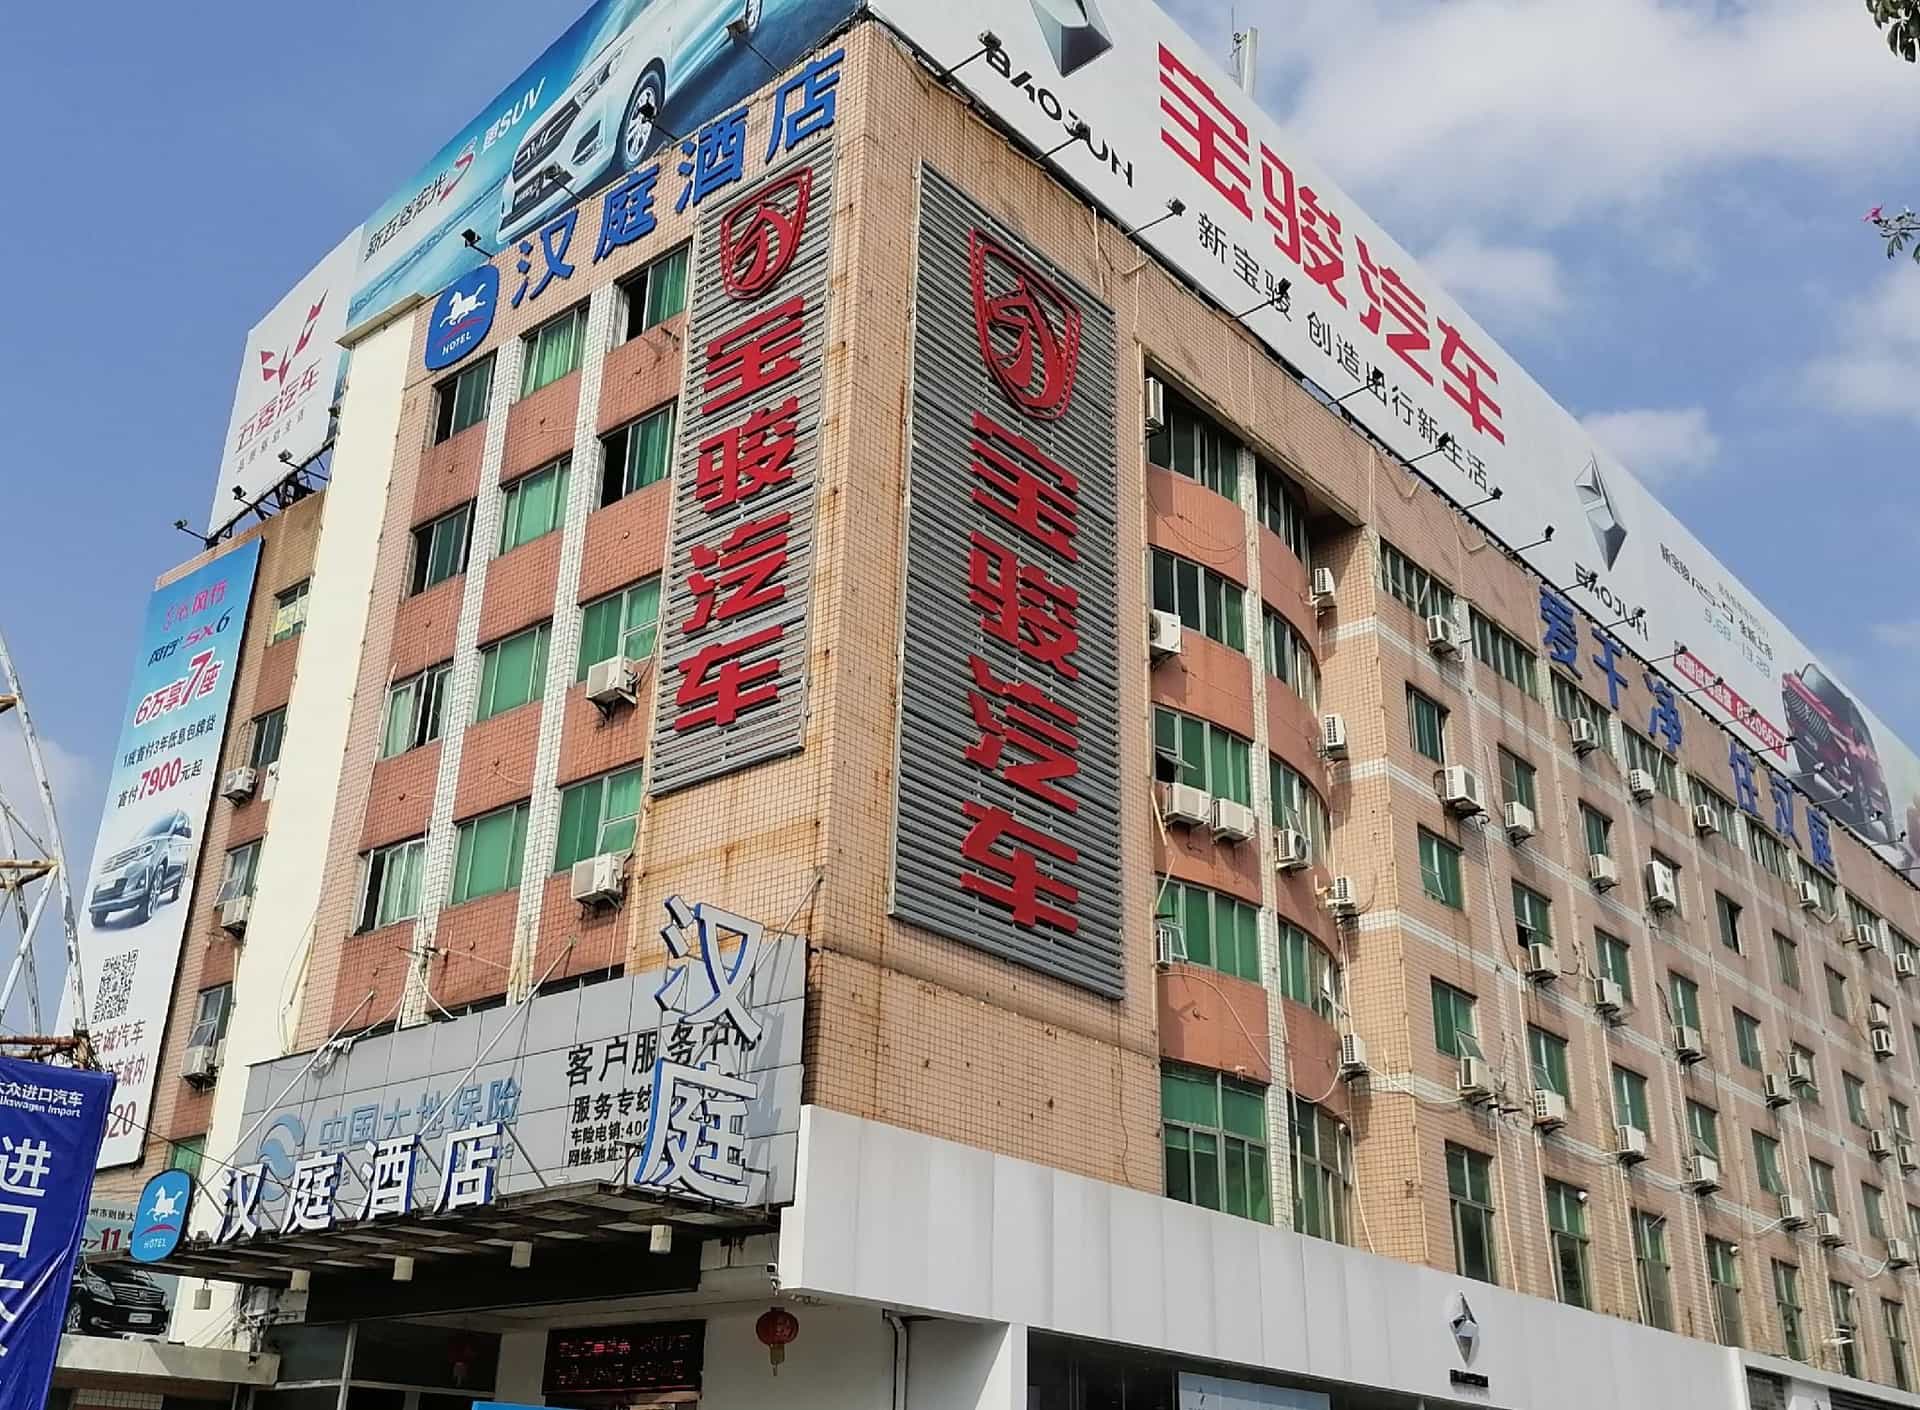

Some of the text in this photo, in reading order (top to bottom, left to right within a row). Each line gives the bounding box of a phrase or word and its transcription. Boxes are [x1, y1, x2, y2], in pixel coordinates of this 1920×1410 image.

[512, 48, 846, 307] 汉庭酒店
[1158, 41, 1505, 447] 宝骏汽车
[442, 331, 472, 356] HOTEL
[1197, 211, 1488, 493] 新宝骏 创造出行新生活
[673, 295, 806, 732] 宝骏汽车
[135, 650, 223, 726] 6万享7座
[960, 410, 1079, 934] 宝骏汽车
[1539, 584, 1682, 754] 爱干净
[117, 757, 203, 809] 首付7900元起
[47, 1103, 81, 1119] Import
[633, 893, 764, 1205] 汉庭
[104, 1100, 137, 1139] 20
[319, 1077, 522, 1150] 中国大地保险
[143, 1237, 168, 1250] HOTEL
[212, 1120, 506, 1245] 汉庭酒店
